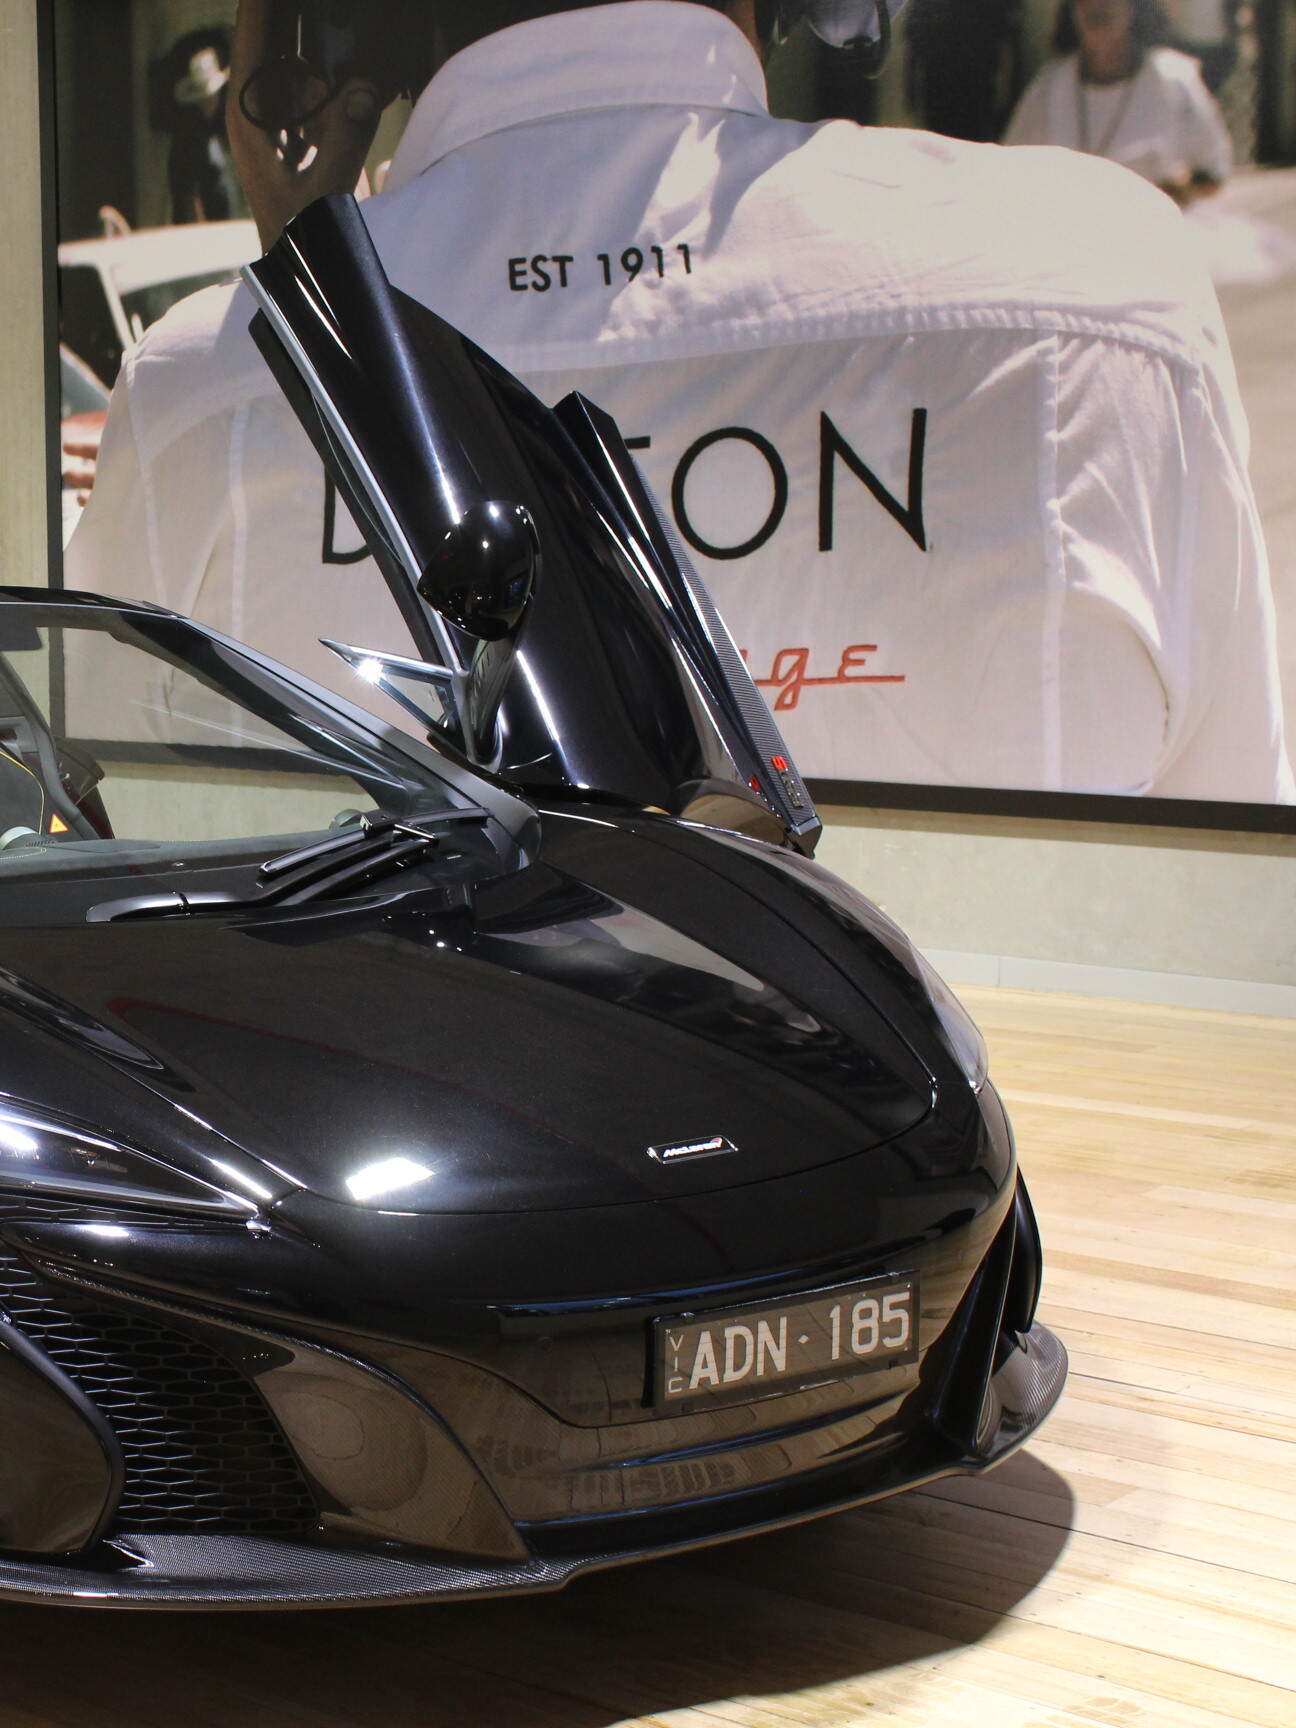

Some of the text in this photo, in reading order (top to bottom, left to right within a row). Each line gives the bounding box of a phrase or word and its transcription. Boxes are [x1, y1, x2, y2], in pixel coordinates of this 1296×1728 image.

[509, 243, 692, 293] EST 1911
[688, 1291, 911, 1390] ADN 185
